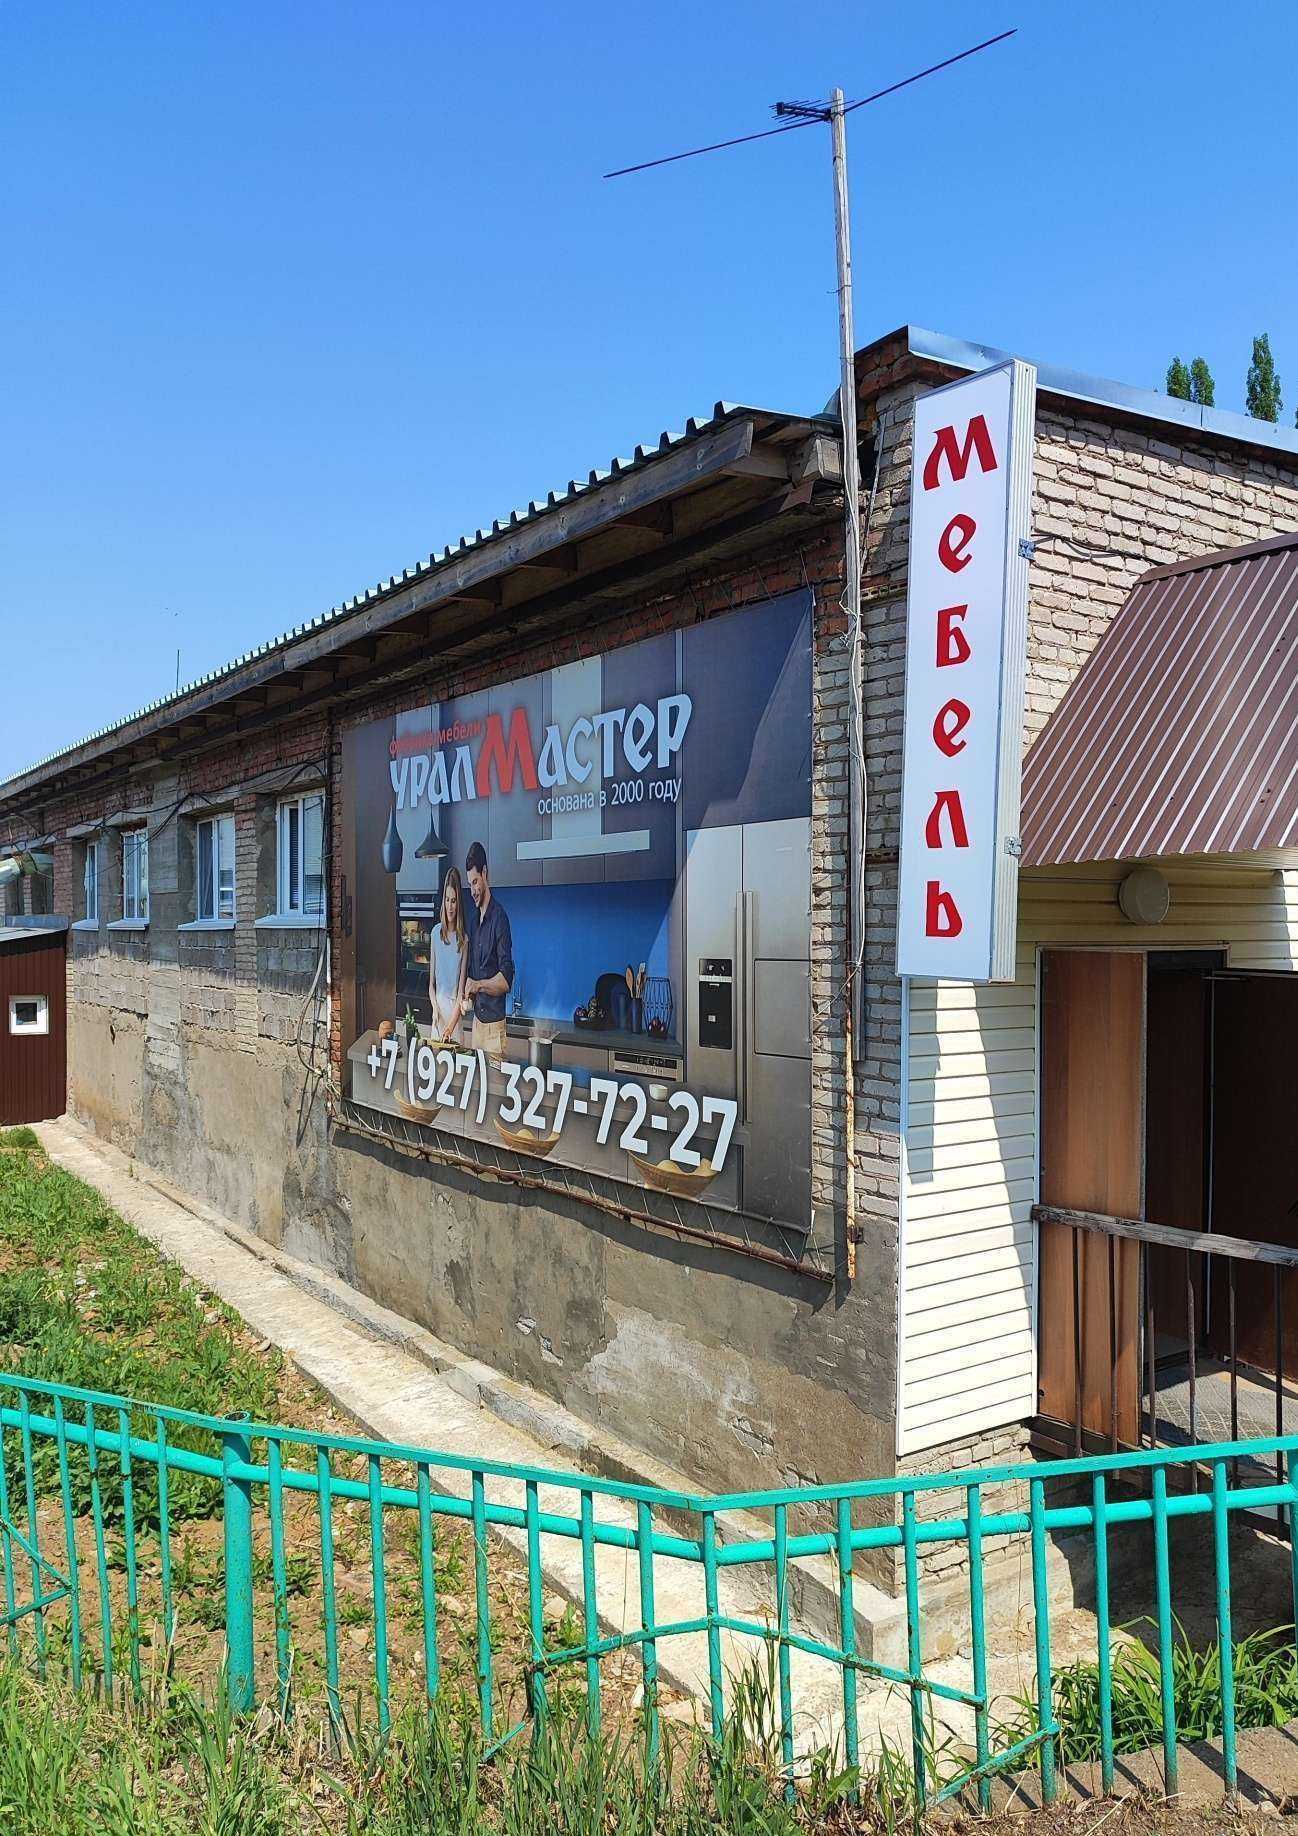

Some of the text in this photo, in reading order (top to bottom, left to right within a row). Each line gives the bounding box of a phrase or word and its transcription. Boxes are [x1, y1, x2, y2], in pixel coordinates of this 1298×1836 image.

[538, 778, 682, 815] основана в 2000 году
[368, 1037, 739, 1172] +7 (927) 327-72-27
